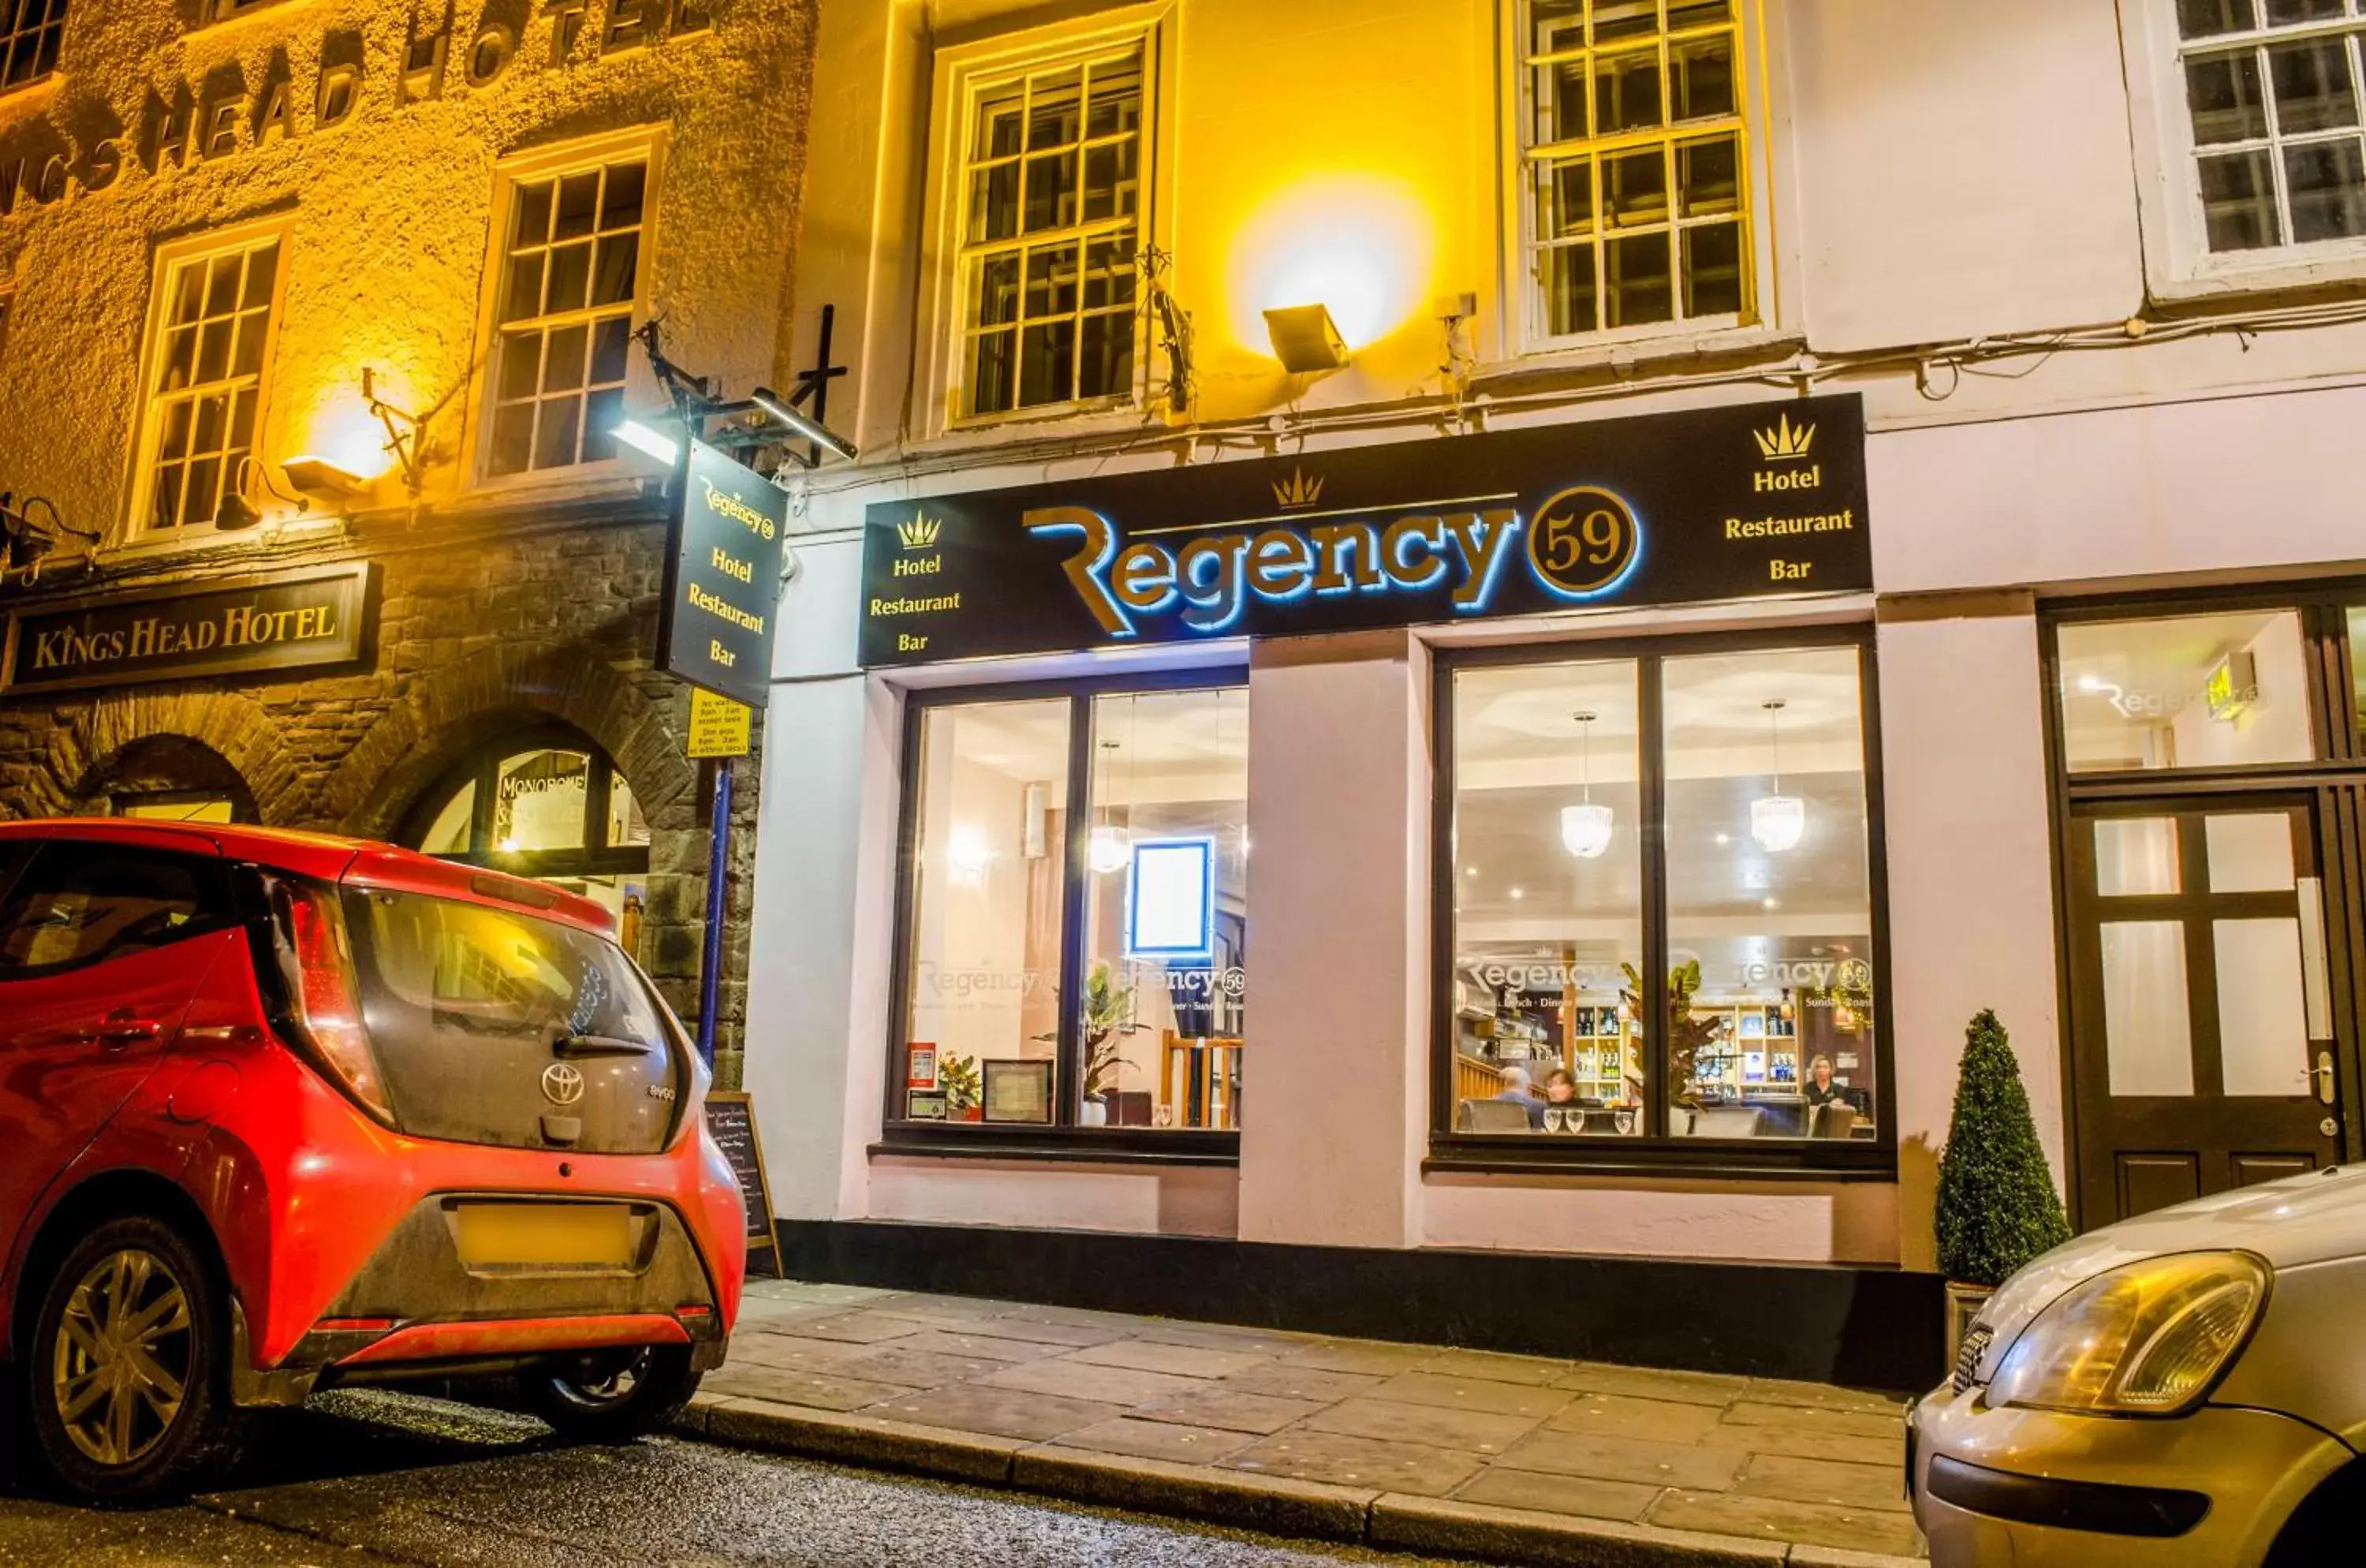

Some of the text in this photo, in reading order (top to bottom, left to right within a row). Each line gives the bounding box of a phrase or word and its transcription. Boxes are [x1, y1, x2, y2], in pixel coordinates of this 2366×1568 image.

[155, 62, 364, 173] HEAD
[1753, 465, 1820, 493] Hotel
[698, 475, 763, 534] Regency
[1726, 510, 1853, 539] Restaurant
[712, 546, 752, 584] Hotel
[894, 554, 942, 577] Hotel
[1022, 506, 1621, 637] Regency 59
[1770, 558, 1812, 581] Bar
[689, 583, 764, 636] Restaurant
[870, 591, 961, 617] Restaurant
[33, 605, 336, 670] KINGS HEAD HOTEL
[898, 633, 928, 653] Bar
[710, 640, 736, 668] Bar
[919, 959, 1041, 998] Regency
[1224, 973, 1245, 992] 59
